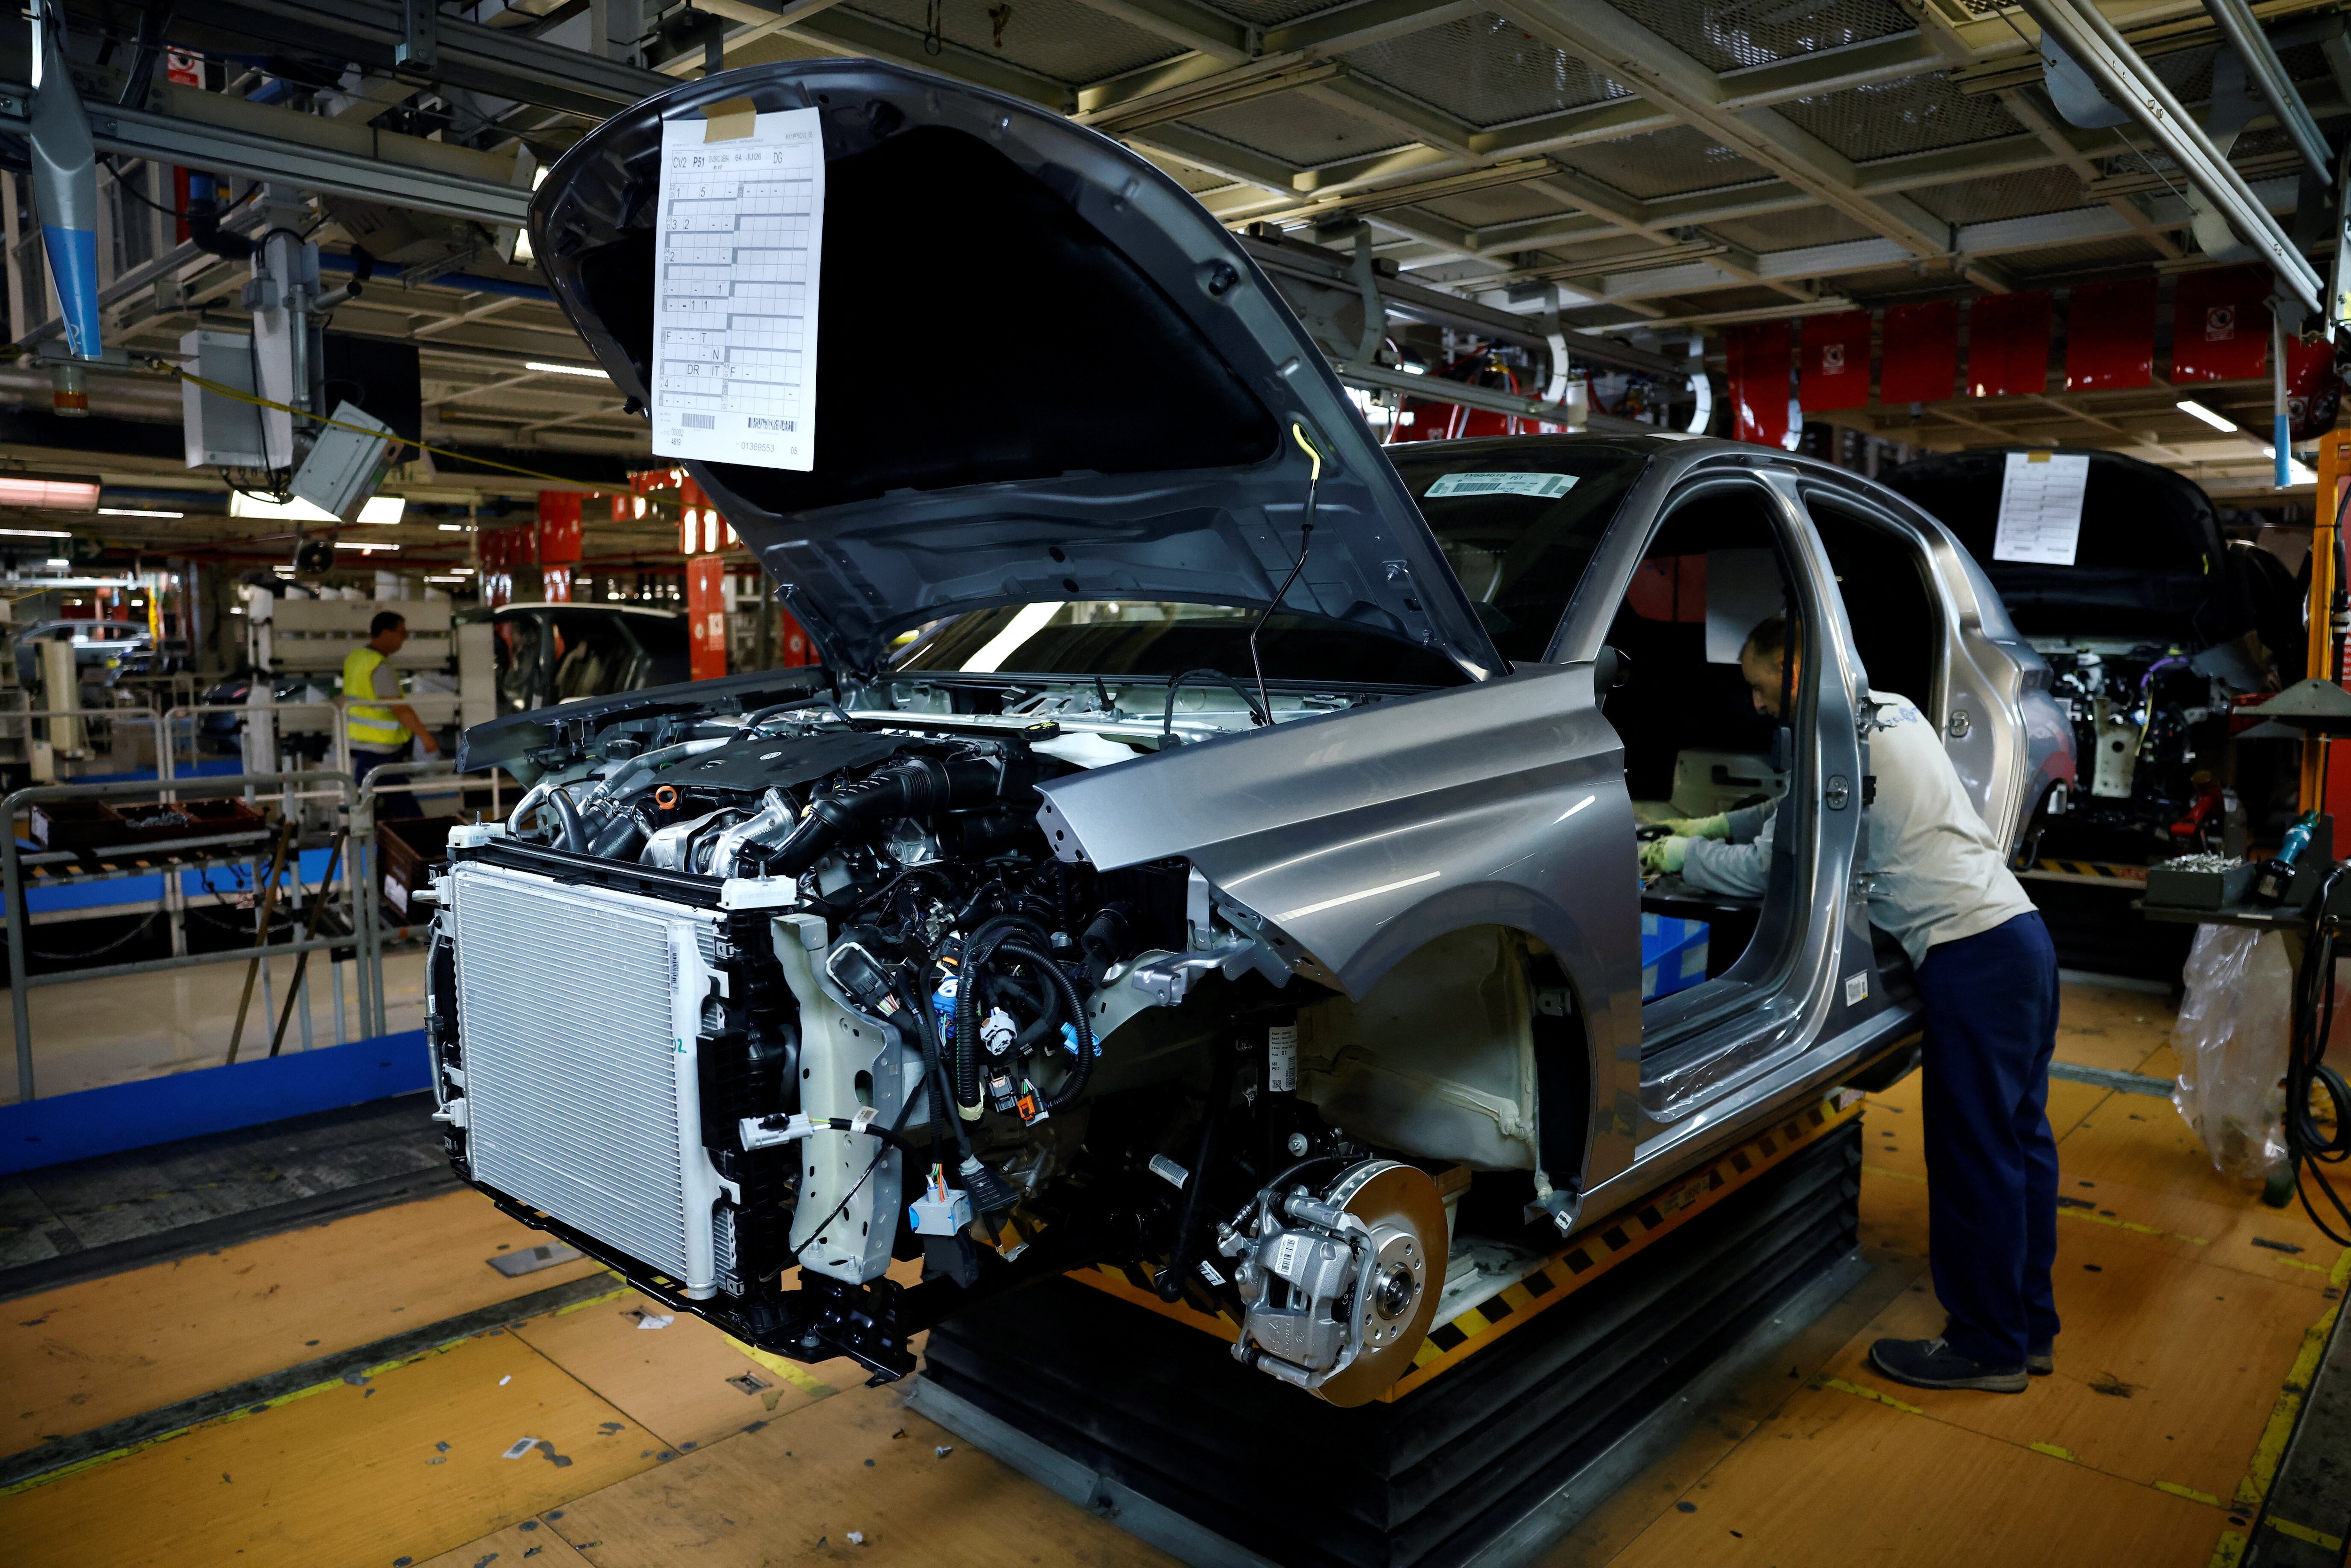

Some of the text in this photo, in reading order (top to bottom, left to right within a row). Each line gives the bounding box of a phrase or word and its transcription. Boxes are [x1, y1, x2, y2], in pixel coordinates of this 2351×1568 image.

[673, 157, 687, 168] CV2
[693, 156, 705, 168] P51
[773, 152, 782, 164] DG
[677, 188, 680, 198] 1
[701, 187, 706, 197] 5
[672, 220, 677, 230] 3
[684, 219, 689, 229] 2
[670, 252, 675, 262] 2
[718, 284, 721, 295] 1
[692, 300, 708, 311] 1 1
[667, 331, 671, 341] F
[702, 332, 707, 343] T
[713, 349, 719, 360] N
[687, 364, 720, 377] DR IT
[730, 367, 736, 377] F
[664, 378, 669, 389] 4
[671, 428, 684, 437] 00002
[741, 441, 775, 453] 01369553
